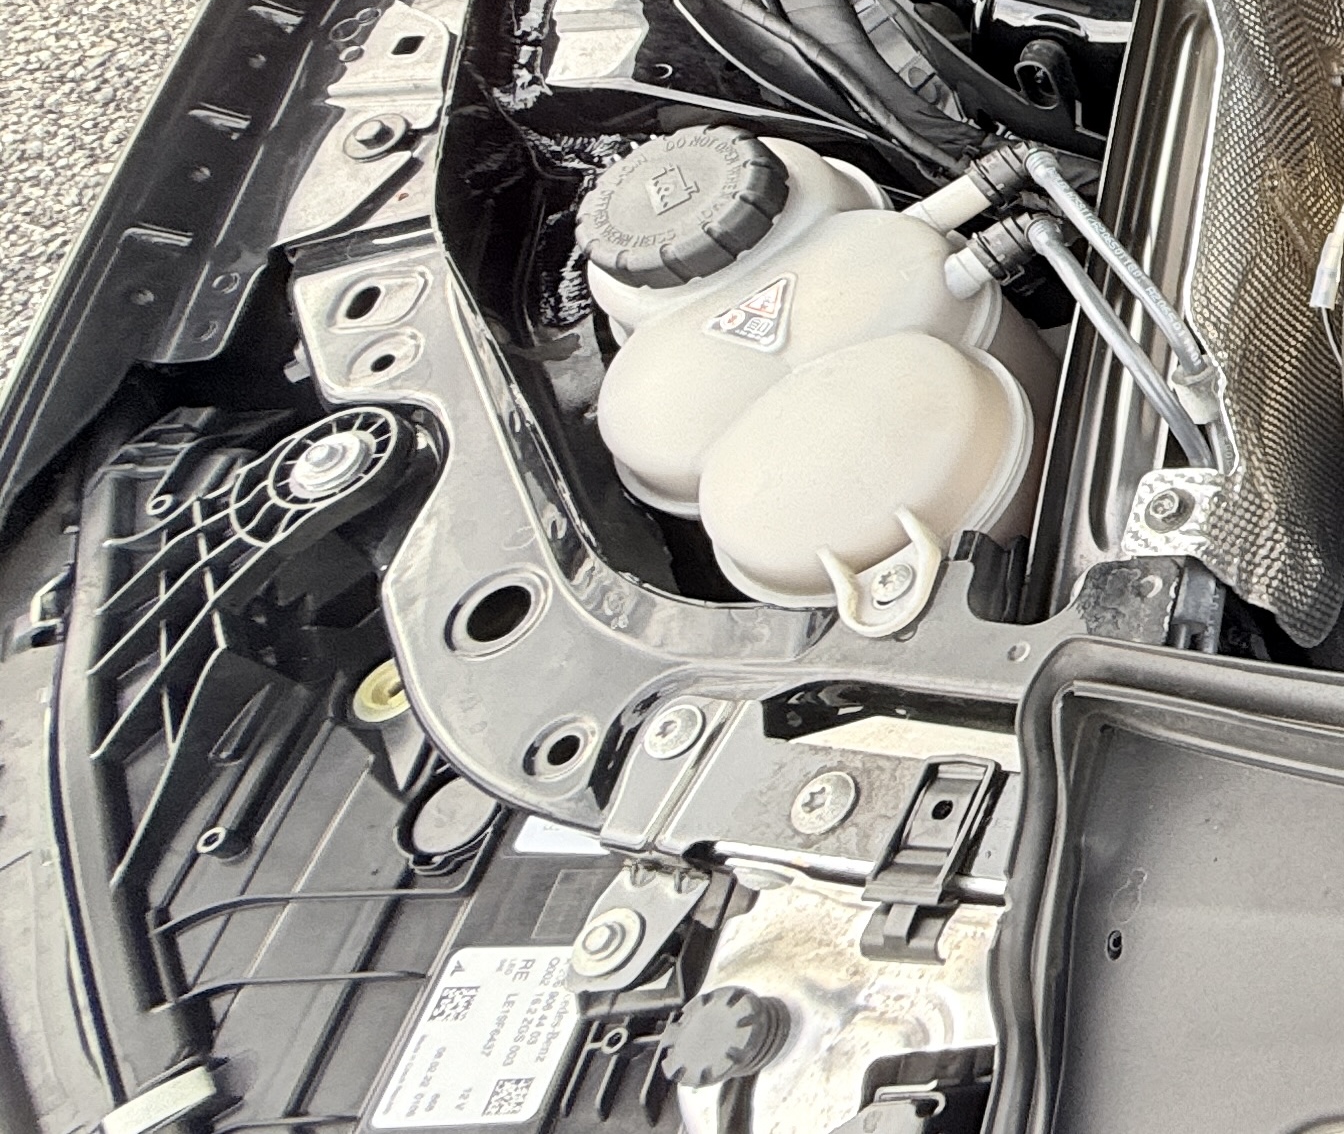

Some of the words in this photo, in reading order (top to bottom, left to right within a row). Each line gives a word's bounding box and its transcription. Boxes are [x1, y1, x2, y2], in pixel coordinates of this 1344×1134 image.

[665, 136, 687, 152] DO
[688, 135, 716, 148] NOT
[511, 958, 536, 982] RE
[512, 1017, 534, 1042] ZGS
[457, 1087, 473, 1100] 12
